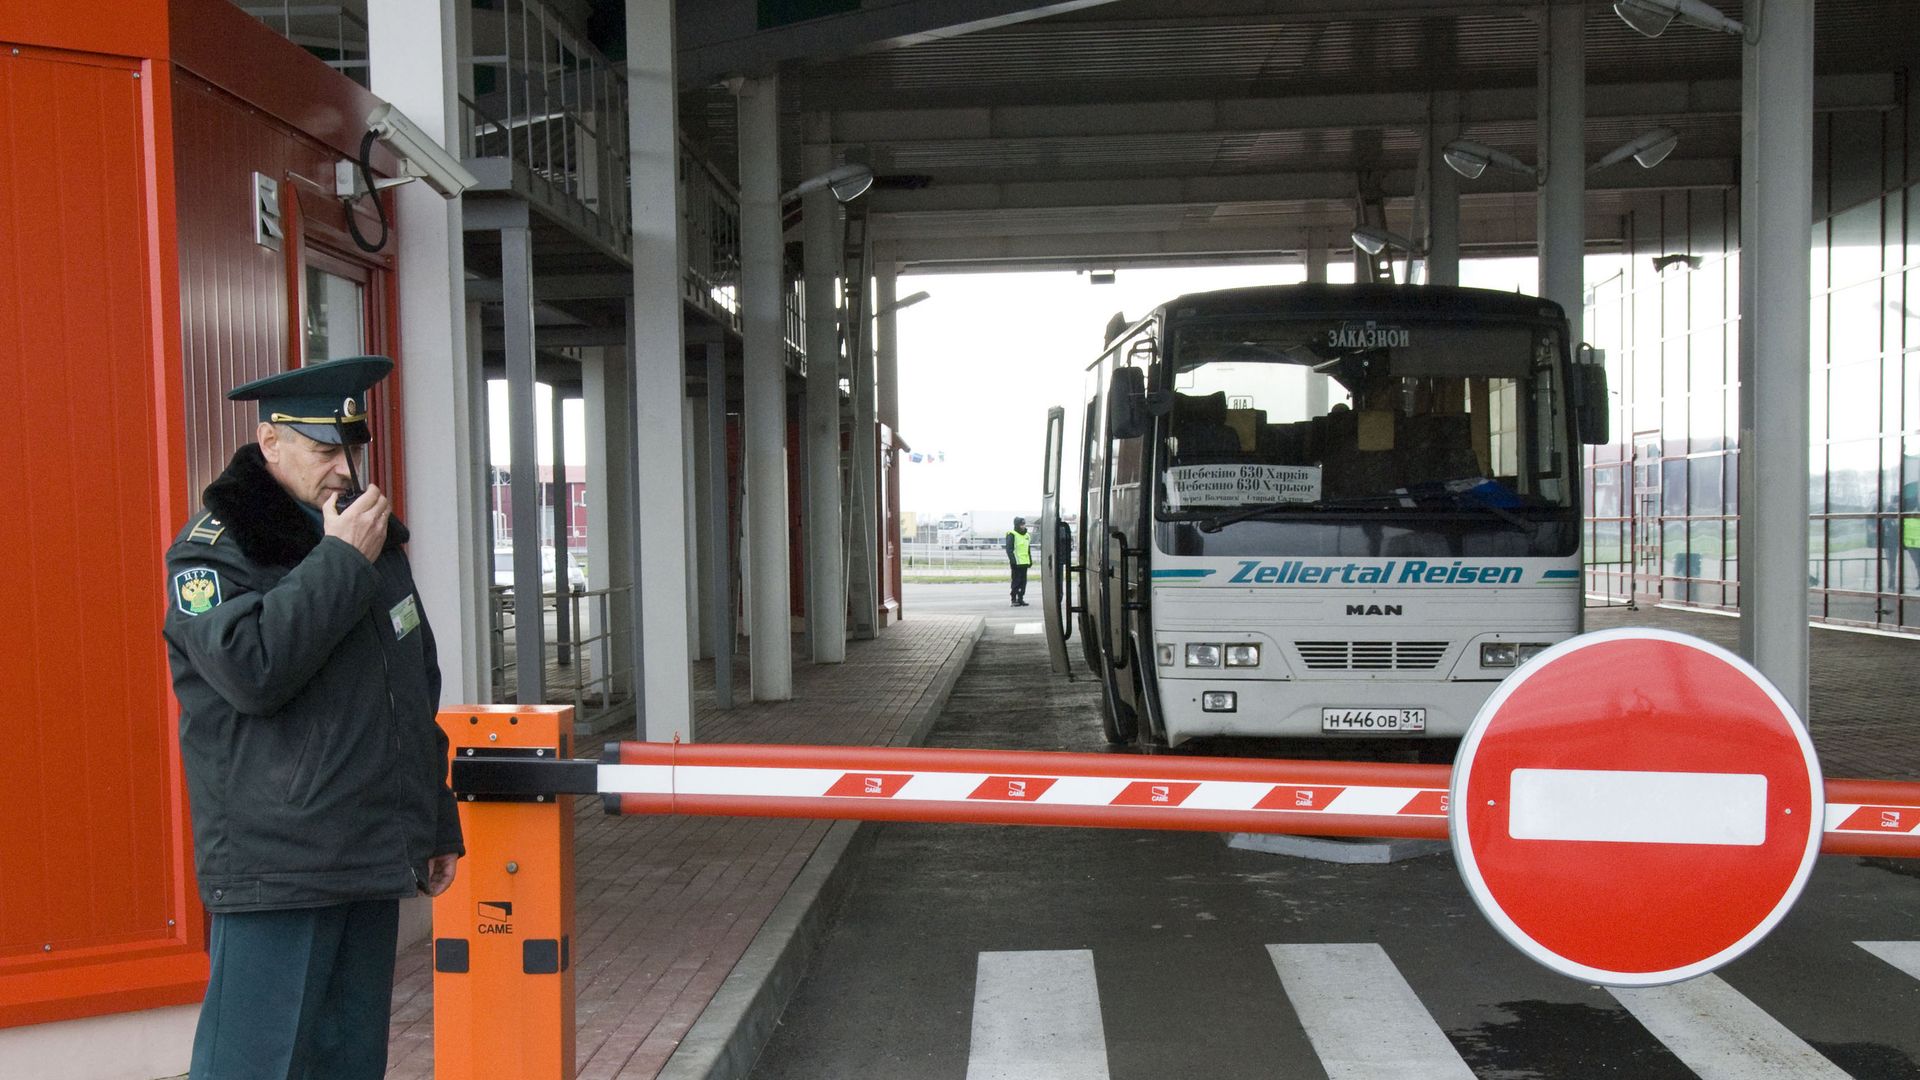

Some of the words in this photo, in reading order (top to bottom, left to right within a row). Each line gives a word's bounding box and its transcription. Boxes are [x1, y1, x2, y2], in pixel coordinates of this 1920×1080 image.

[1239, 466, 1263, 479] 630
[1236, 478, 1260, 491] 630
[184, 570, 207, 581] ЦТУ
[1228, 560, 1396, 584] Zellertal
[1398, 560, 1524, 584] Reisen
[1346, 604, 1402, 616] MAN
[1402, 710, 1419, 723] 31
[477, 923, 513, 935] CAME
